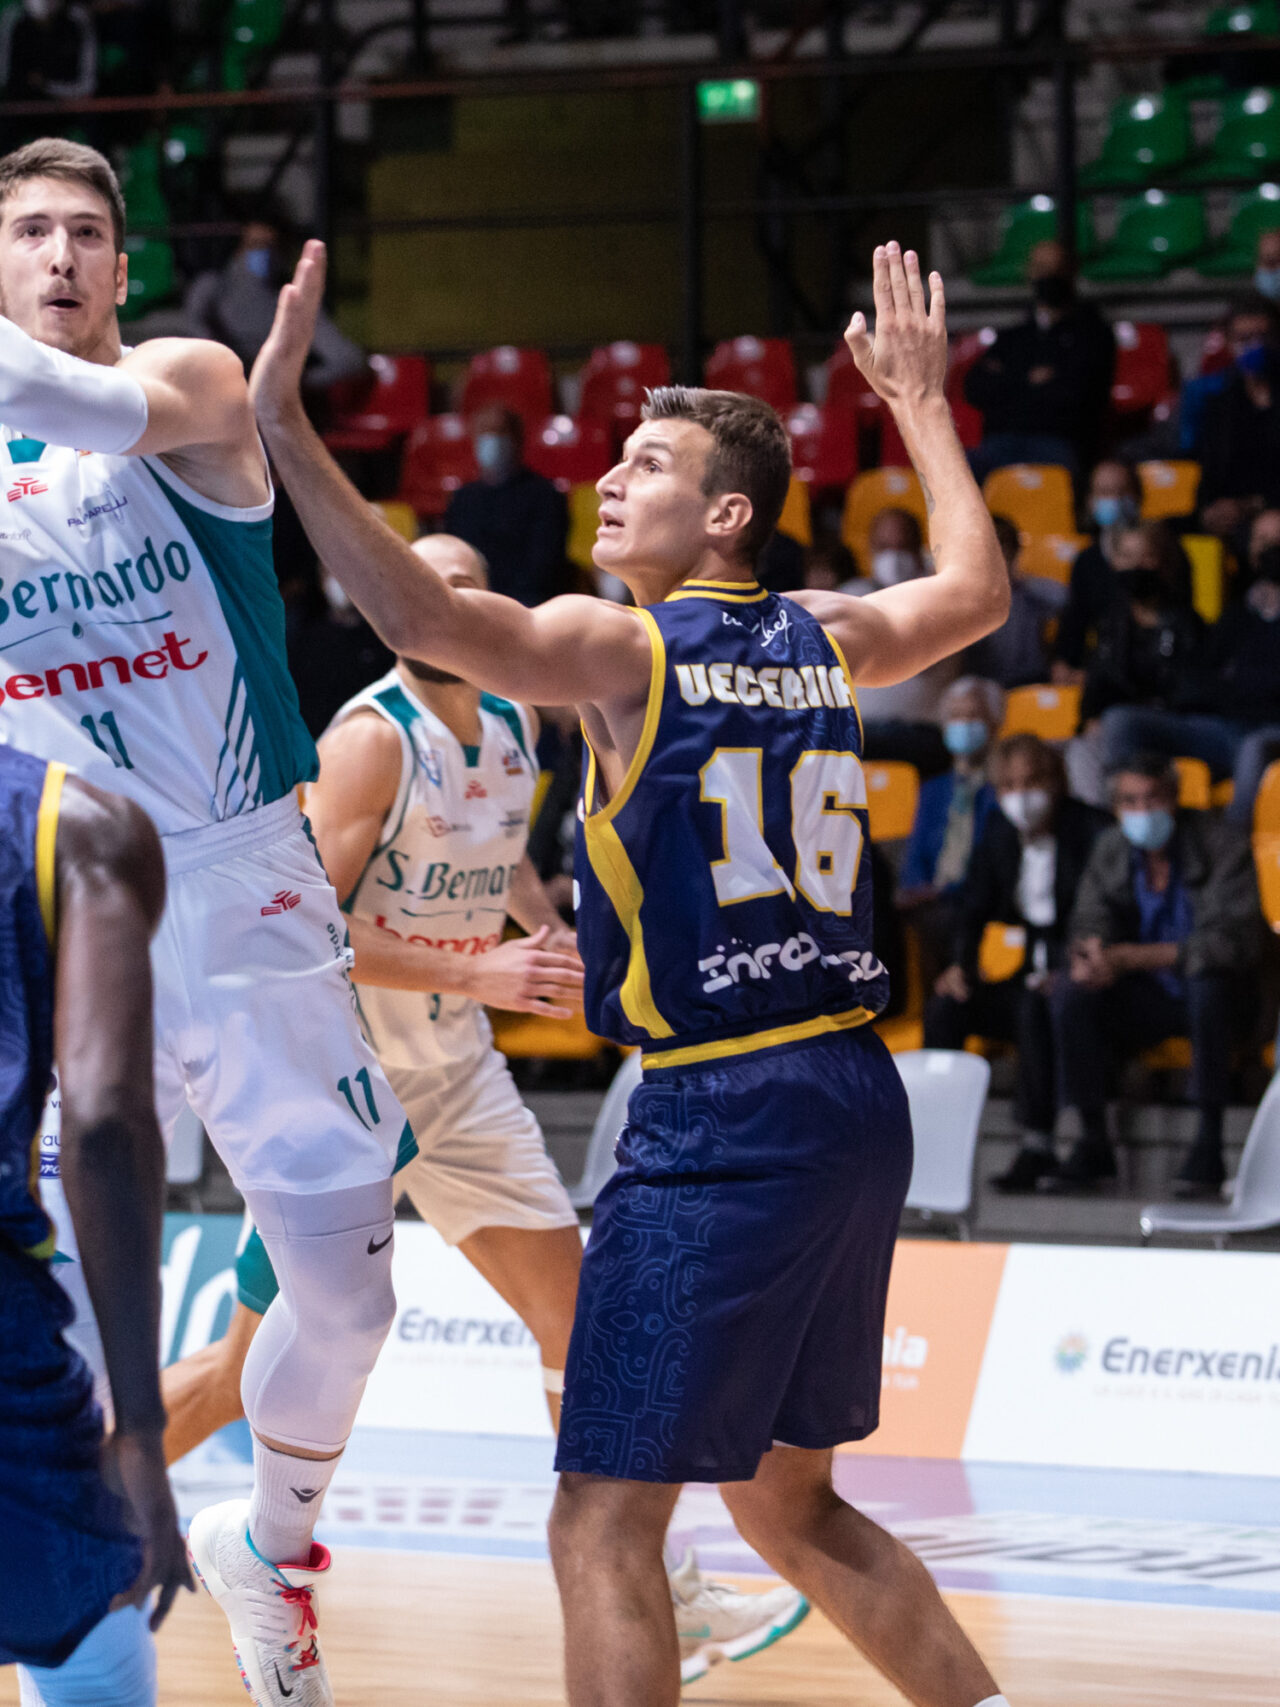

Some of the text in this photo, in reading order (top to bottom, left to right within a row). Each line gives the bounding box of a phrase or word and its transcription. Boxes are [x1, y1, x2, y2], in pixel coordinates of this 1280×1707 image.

[80, 710, 135, 770] 11
[698, 746, 869, 916] 16
[337, 1066, 381, 1133] 11
